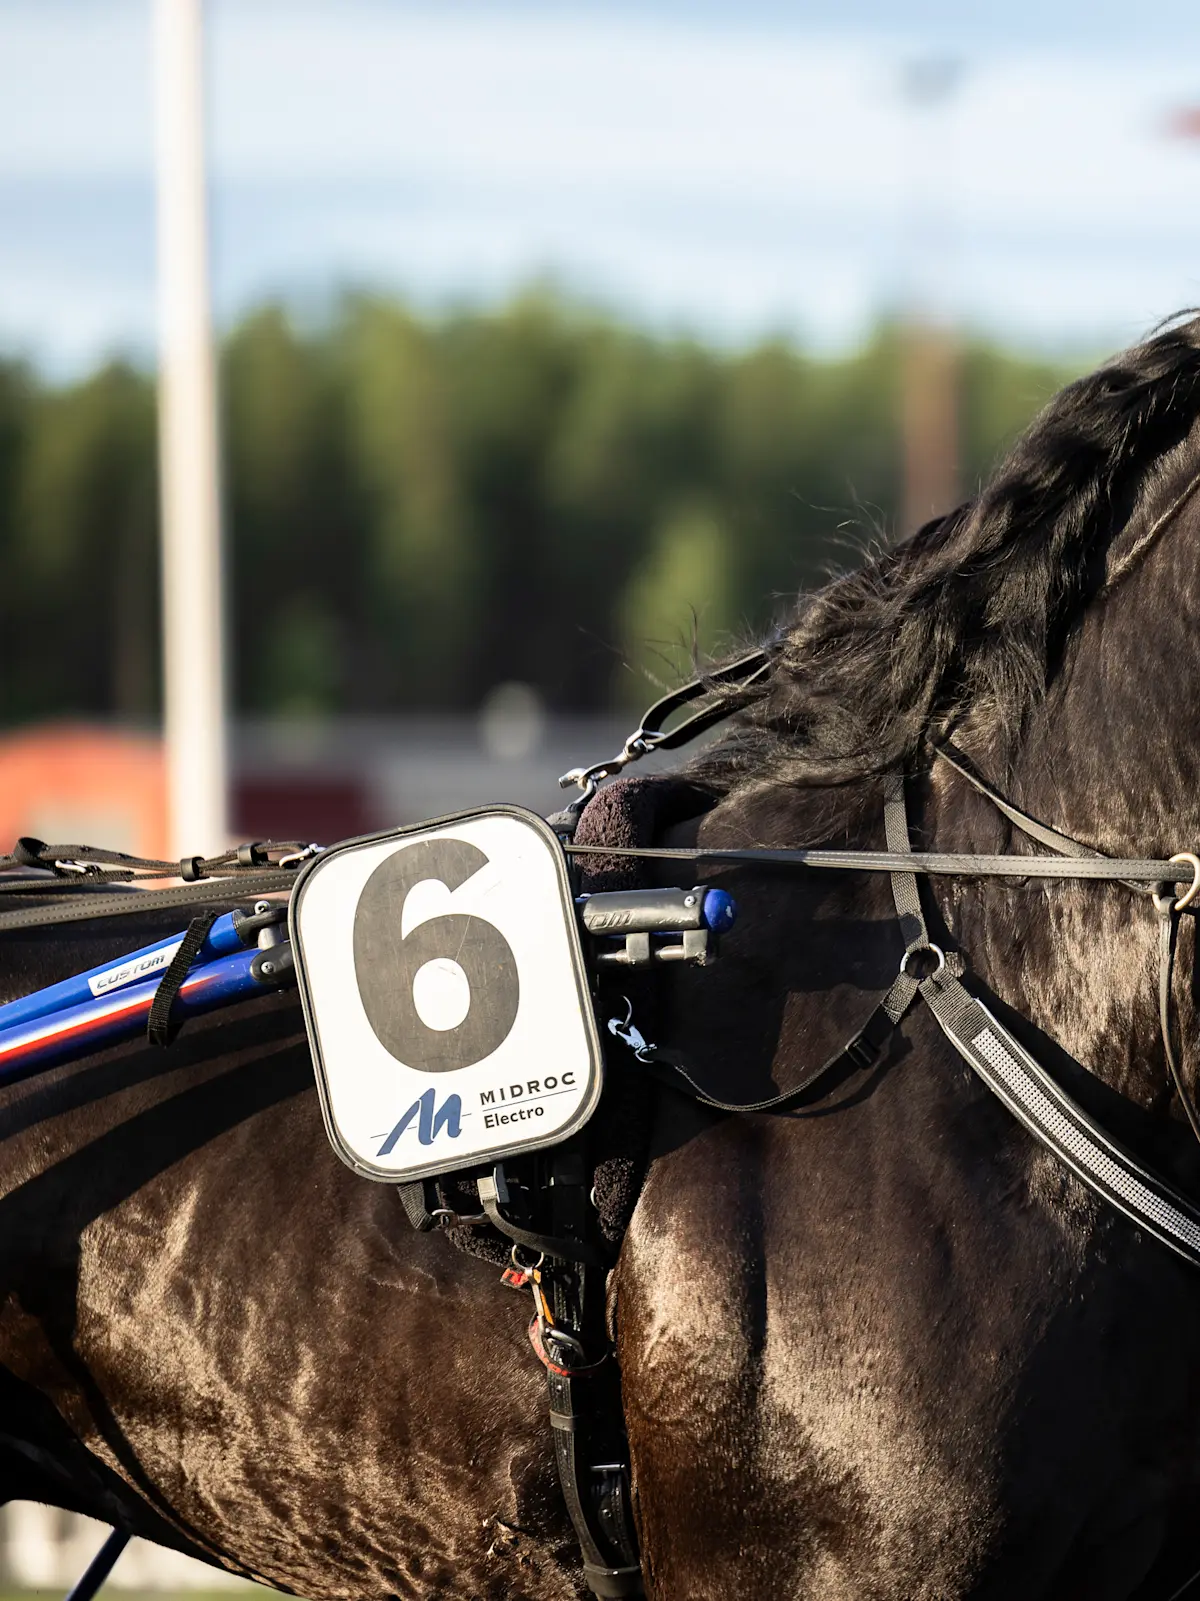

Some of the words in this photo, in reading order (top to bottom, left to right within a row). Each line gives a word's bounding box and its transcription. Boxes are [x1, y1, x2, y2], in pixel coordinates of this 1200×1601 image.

[97, 955, 165, 989] CUSTOM
[353, 838, 520, 1073] 6
[479, 1072, 576, 1105] MIDROC
[484, 1107, 545, 1129] Electro
